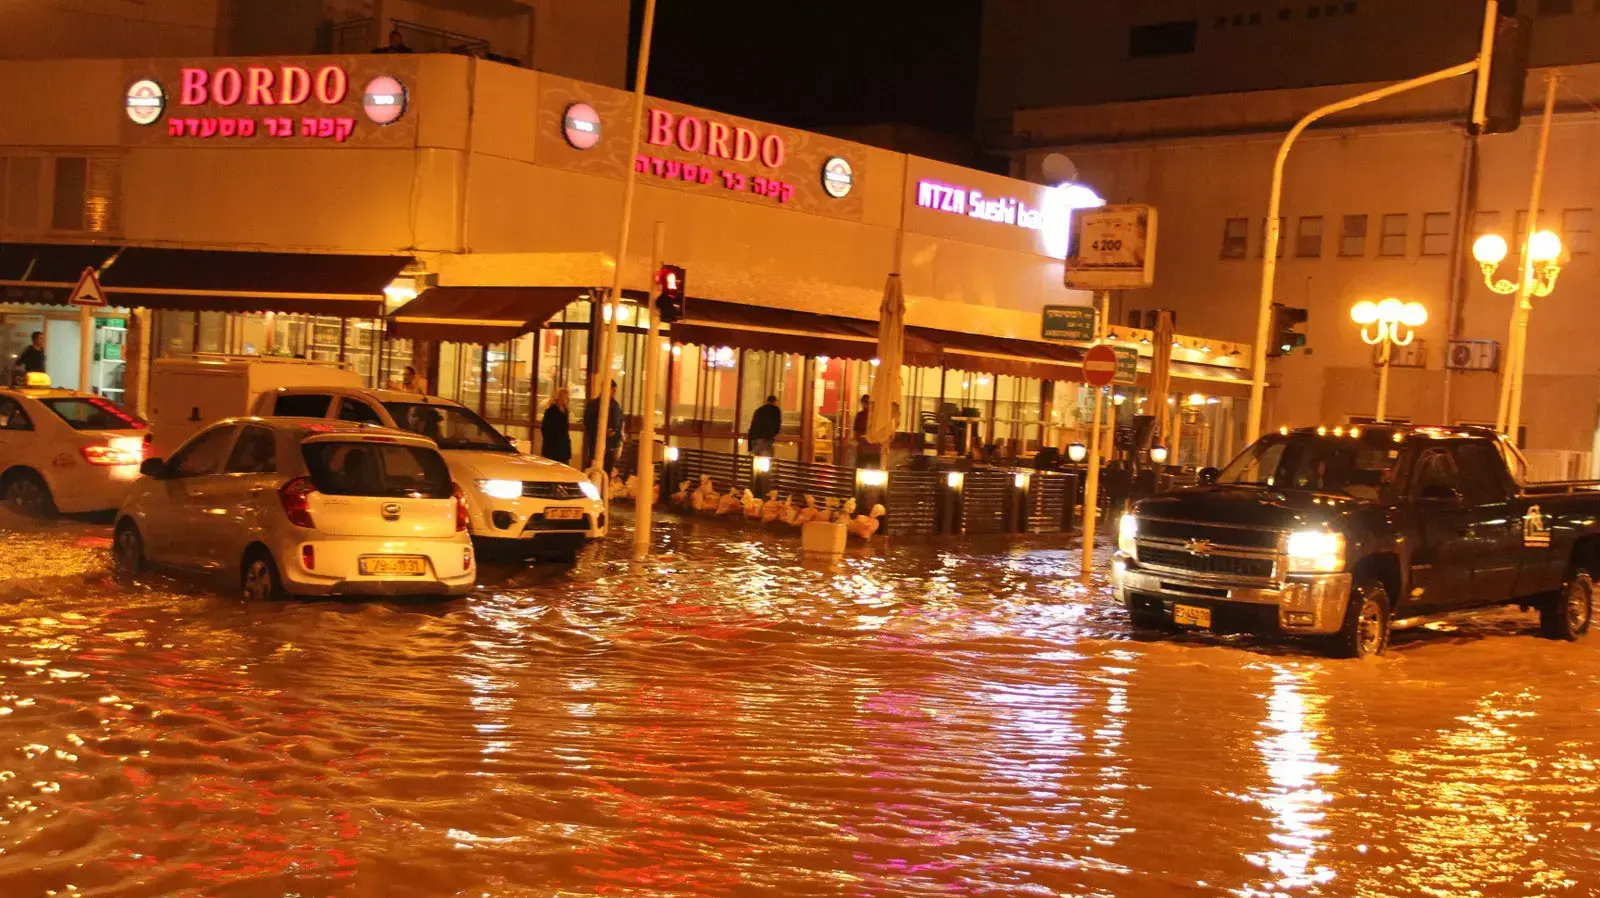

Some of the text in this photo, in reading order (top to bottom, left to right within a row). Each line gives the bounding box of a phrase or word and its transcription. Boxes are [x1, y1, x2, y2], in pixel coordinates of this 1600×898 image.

[180, 66, 347, 106] BORDO
[168, 117, 355, 142] קפה בר מסעדה
[649, 109, 785, 170] BORDO
[634, 154, 715, 184] מסעדה
[718, 169, 747, 191] בר
[752, 176, 796, 204] קפה
[969, 191, 1015, 225] Sushi
